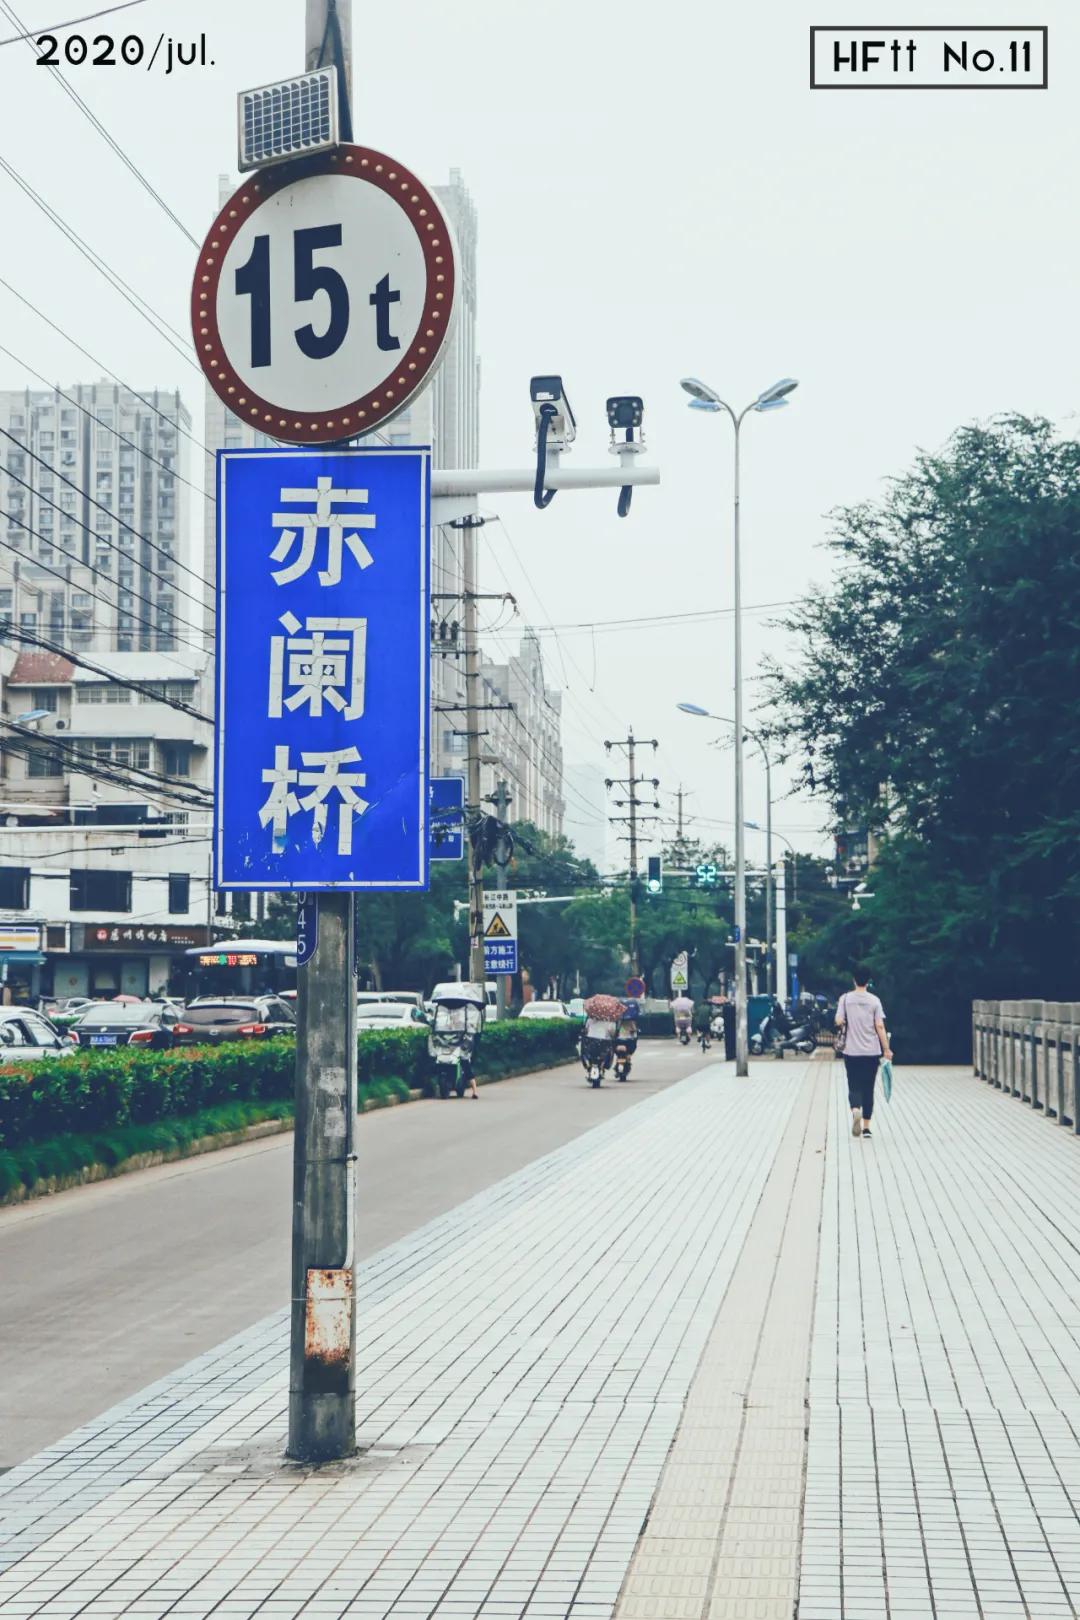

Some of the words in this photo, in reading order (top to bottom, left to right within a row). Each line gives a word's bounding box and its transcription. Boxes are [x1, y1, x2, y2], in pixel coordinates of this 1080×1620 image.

[258, 476, 377, 856] 赤阑桥
[696, 865, 717, 882] 52
